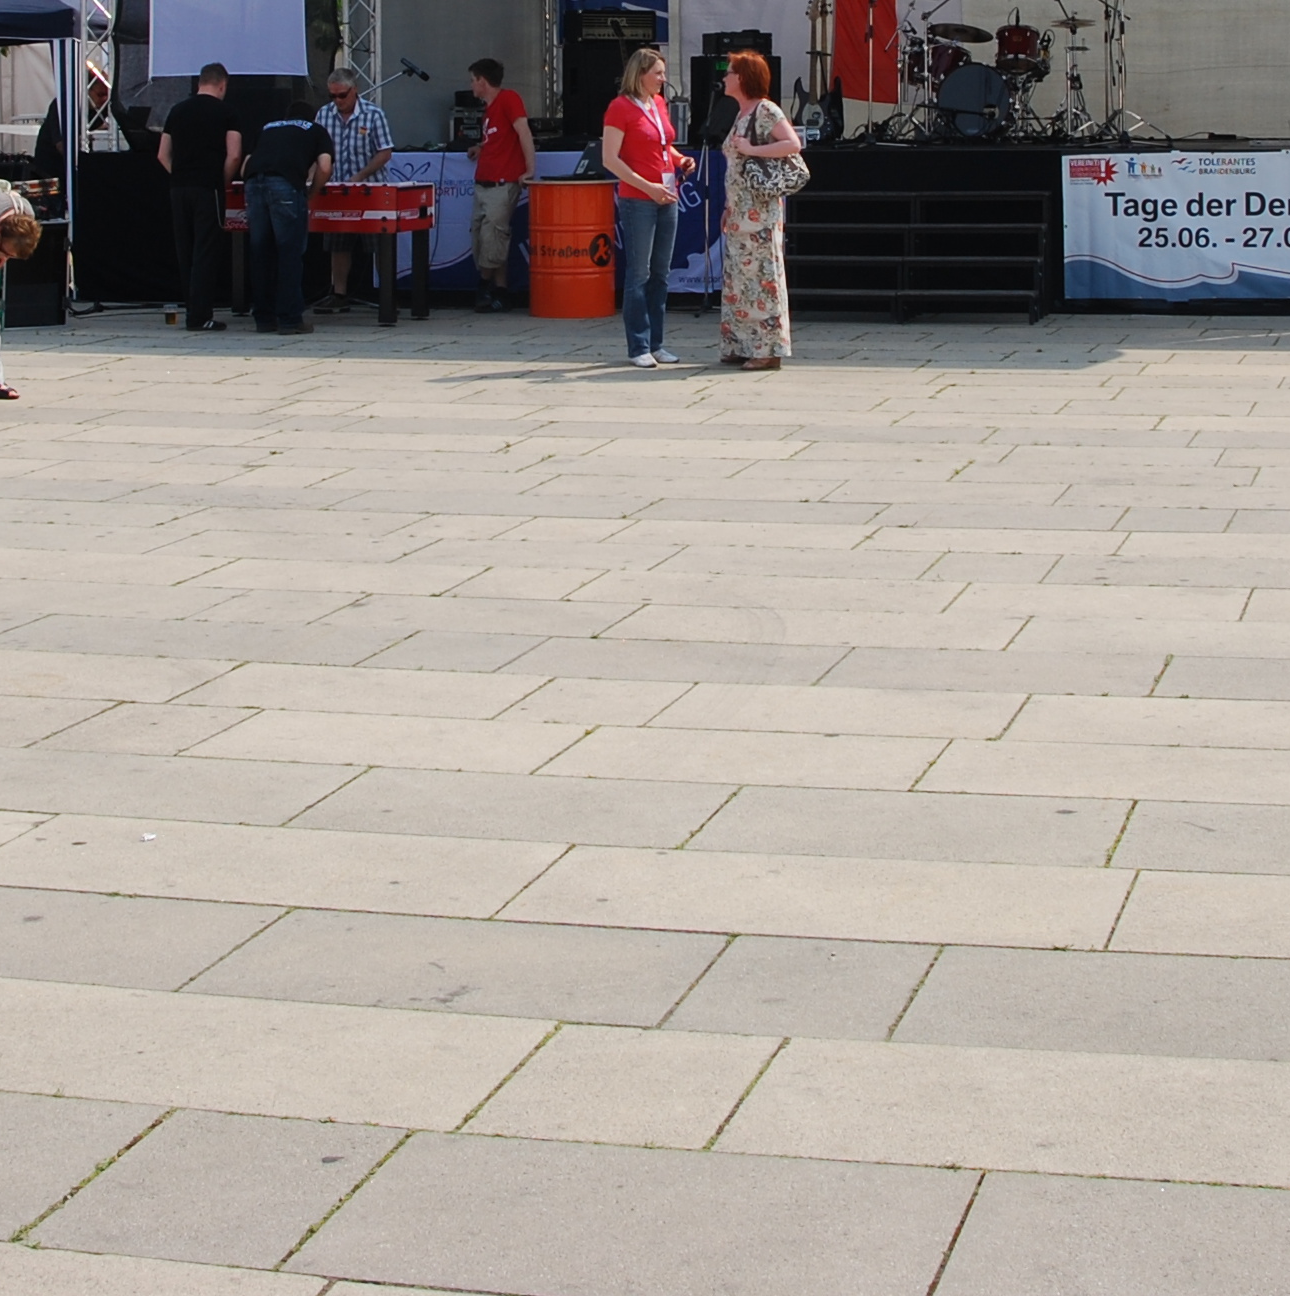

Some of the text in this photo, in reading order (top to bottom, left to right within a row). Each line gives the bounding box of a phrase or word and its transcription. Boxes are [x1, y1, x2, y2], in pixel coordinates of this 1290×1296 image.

[1198, 157, 1256, 166] TOLERANTES
[1104, 191, 1178, 222] Tage
[1185, 191, 1237, 216] der
[1137, 226, 1217, 248] 25.06.
[541, 245, 589, 259] Straßen
